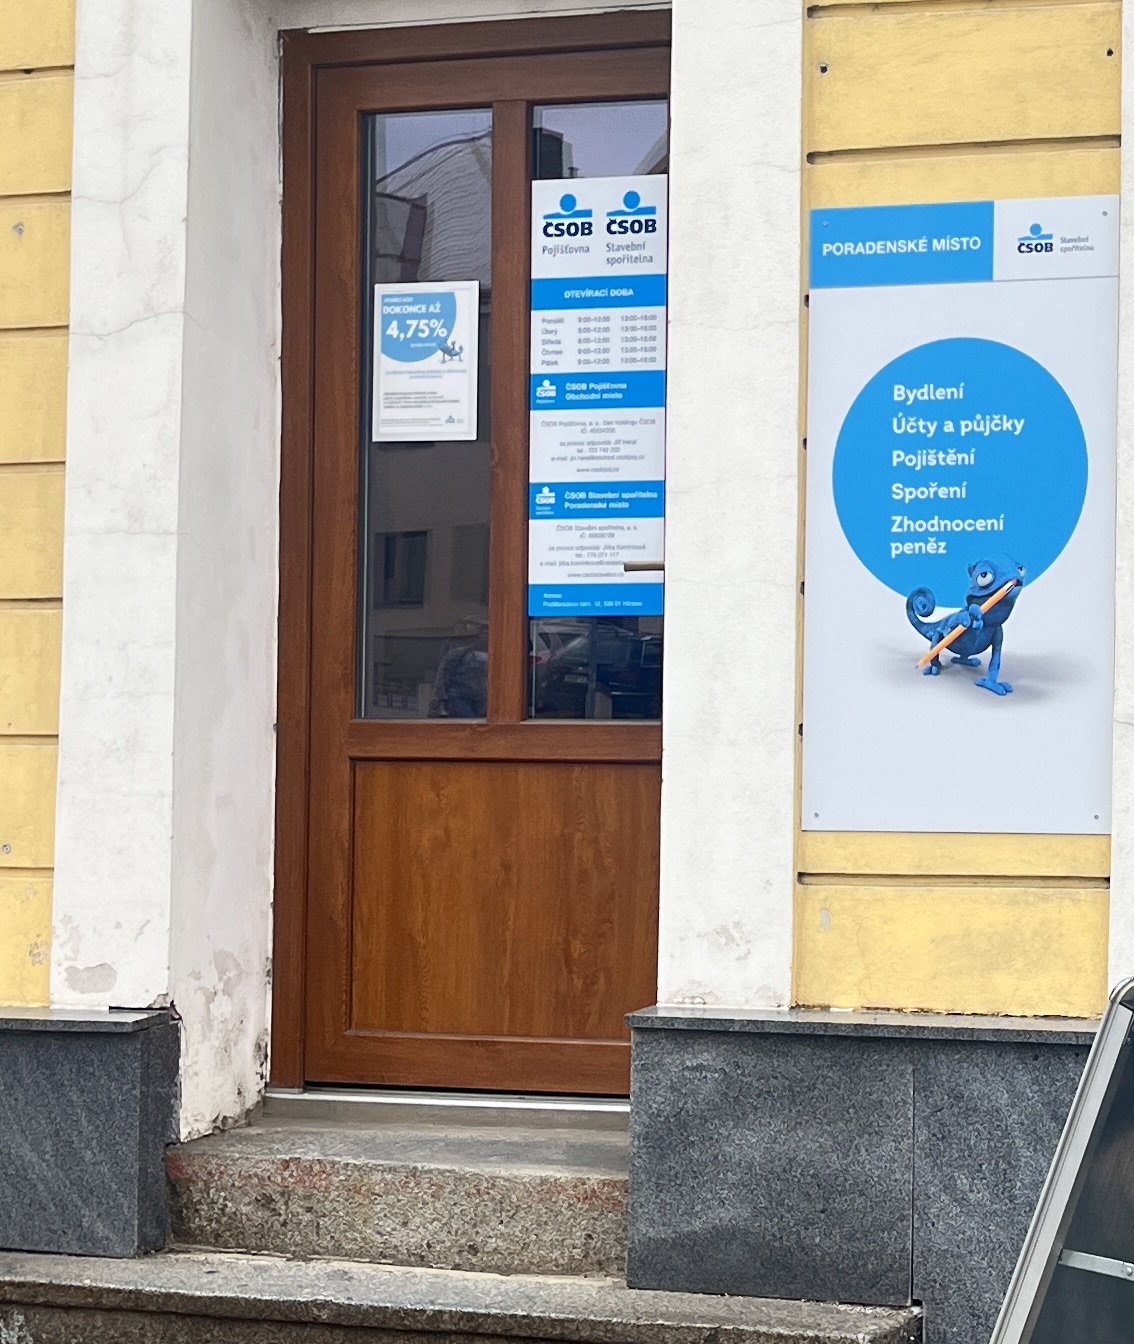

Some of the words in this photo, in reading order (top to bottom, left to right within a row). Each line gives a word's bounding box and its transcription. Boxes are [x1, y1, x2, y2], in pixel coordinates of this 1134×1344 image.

[542, 221, 593, 238] ČSOB
[606, 218, 658, 235] ČSOB
[542, 244, 590, 258] Pojišťovna
[606, 241, 647, 253] Stavební
[822, 236, 928, 256] PORADENSKÉ
[932, 235, 982, 252] MÍSTO
[1017, 242, 1054, 254] ČSOB
[606, 254, 653, 267] spořitelna
[564, 287, 609, 299] OTEVÍRACÍ
[610, 287, 635, 297] DOBA
[385, 318, 449, 342] 4,75%
[893, 382, 964, 405] Bydlení
[892, 413, 938, 437] Účty
[943, 421, 955, 434] a
[960, 413, 1025, 437] půjčky
[892, 448, 976, 470] Pojištění
[891, 481, 967, 503] Spoření
[890, 513, 1005, 534] Zhodnocení
[890, 536, 948, 558] peněz
